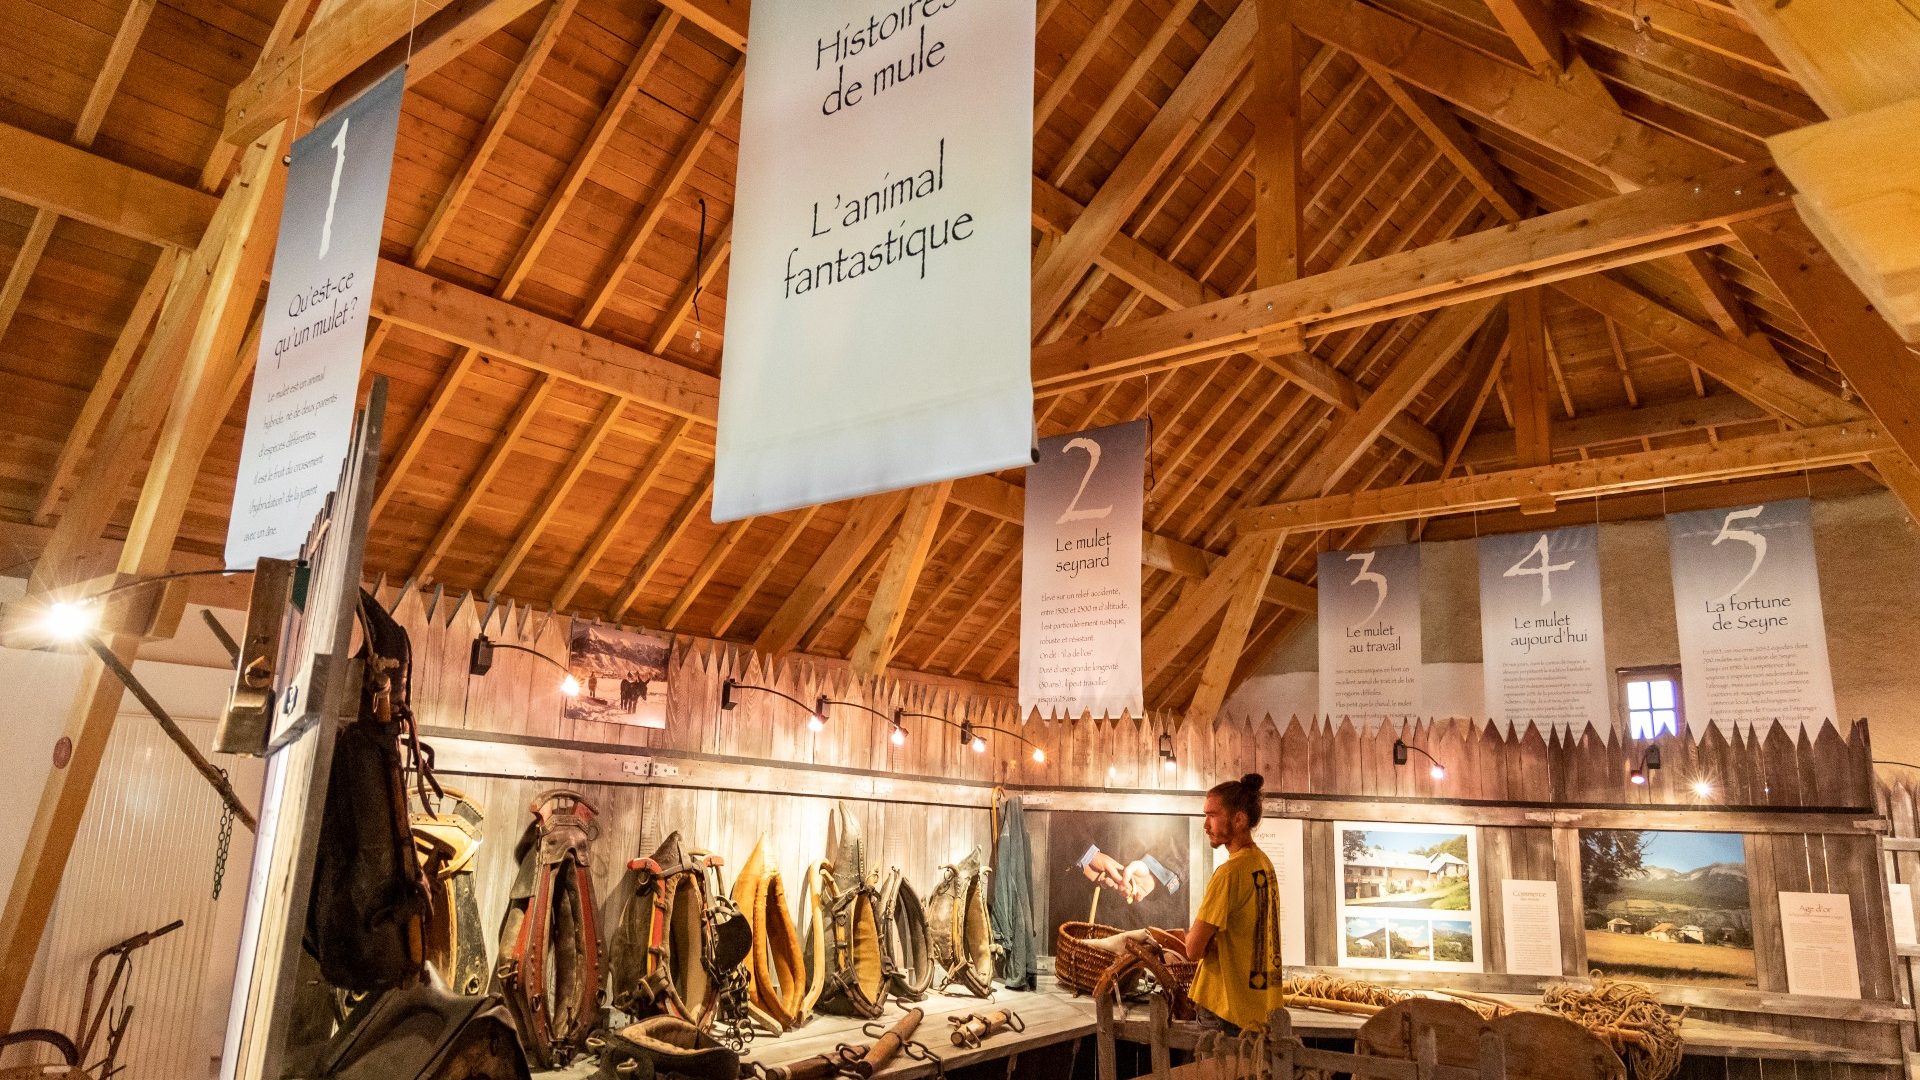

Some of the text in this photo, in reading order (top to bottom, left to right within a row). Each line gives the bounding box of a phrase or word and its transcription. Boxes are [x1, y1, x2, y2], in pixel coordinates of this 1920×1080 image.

[822, 24, 945, 116] de mule
[319, 118, 349, 260] 1
[811, 137, 944, 238] L'animal
[784, 212, 973, 299] fantastique
[288, 272, 354, 317] Qu'est-ce
[275, 326, 310, 369] qu'un
[1055, 437, 1113, 525] 2
[1056, 528, 1112, 552] Le mulet
[1712, 505, 1767, 600] 5
[1056, 547, 1110, 579] seynard
[1503, 534, 1576, 606] 4
[1346, 551, 1388, 627] 3
[1706, 594, 1792, 613] La fortune
[1346, 622, 1395, 638] Le mulet
[1511, 626, 1588, 655] aujourd'hui
[1514, 611, 1570, 629] Le mulet
[1712, 614, 1789, 635] de Seyne
[1349, 636, 1401, 653] au travail
